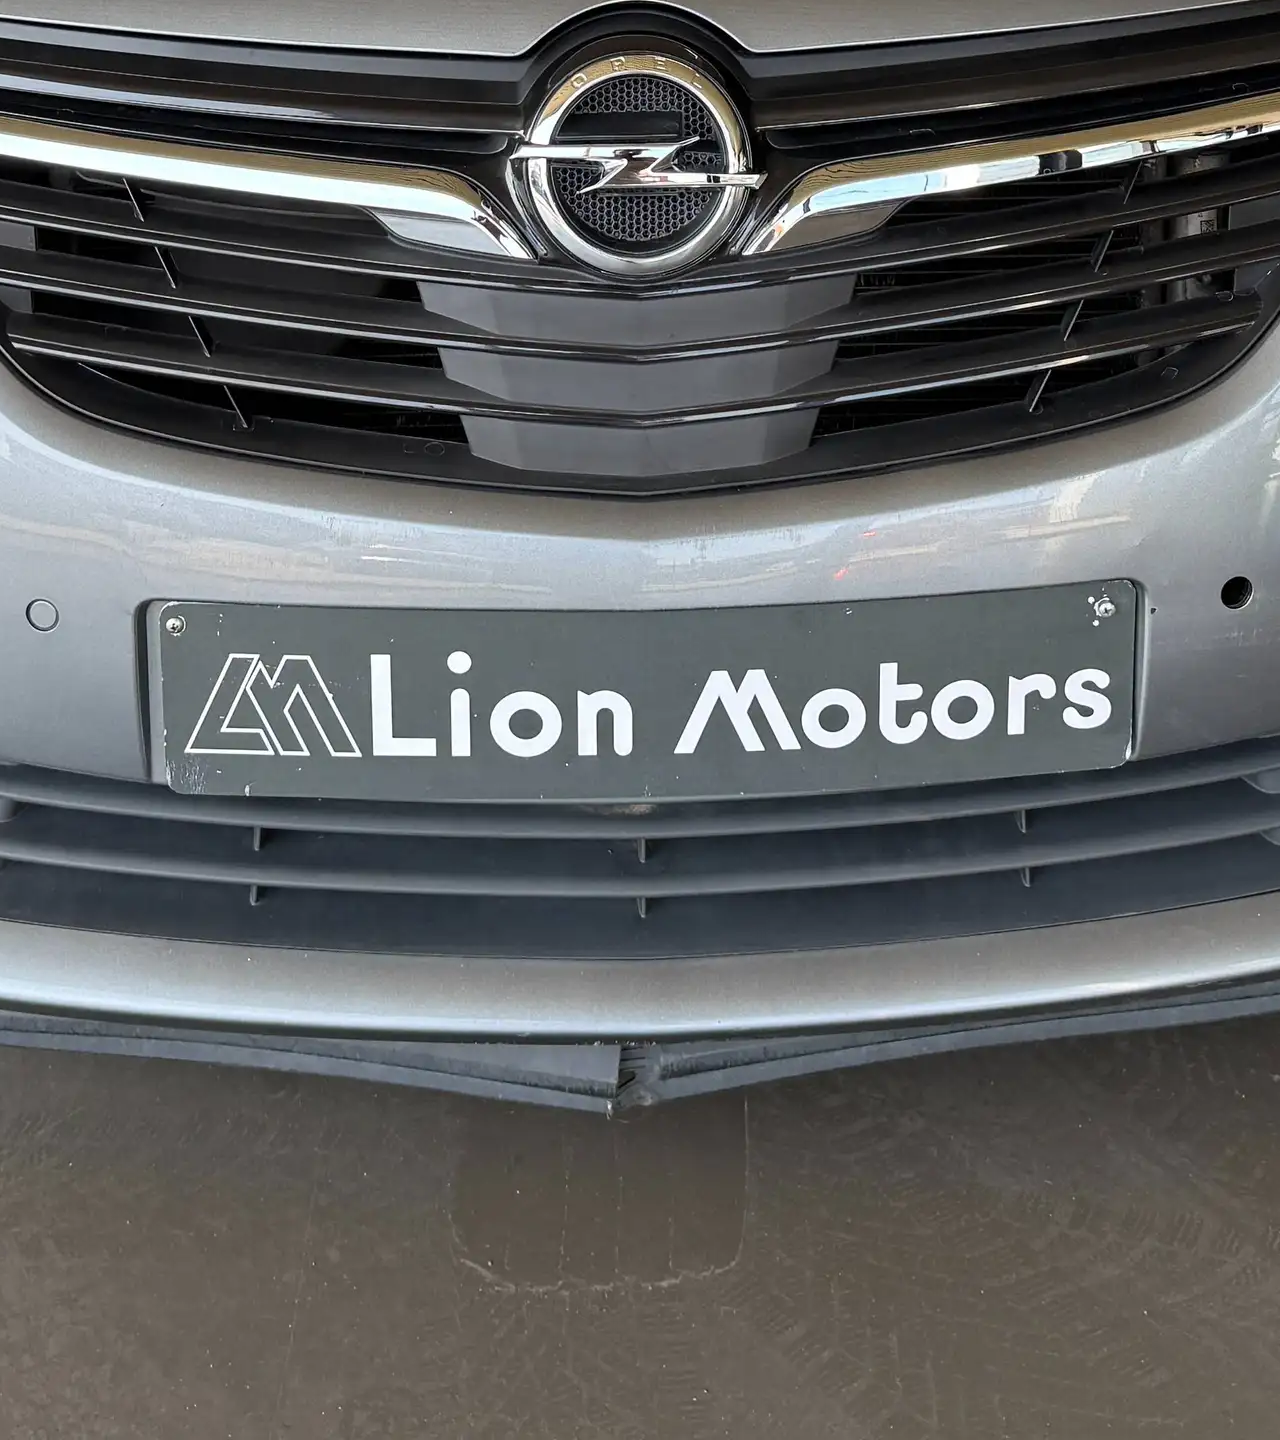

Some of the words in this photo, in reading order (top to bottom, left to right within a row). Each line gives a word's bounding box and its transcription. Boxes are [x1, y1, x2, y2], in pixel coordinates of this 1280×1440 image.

[571, 55, 703, 90] OPEL
[370, 650, 634, 758] Lion
[674, 662, 1112, 755] Motors
